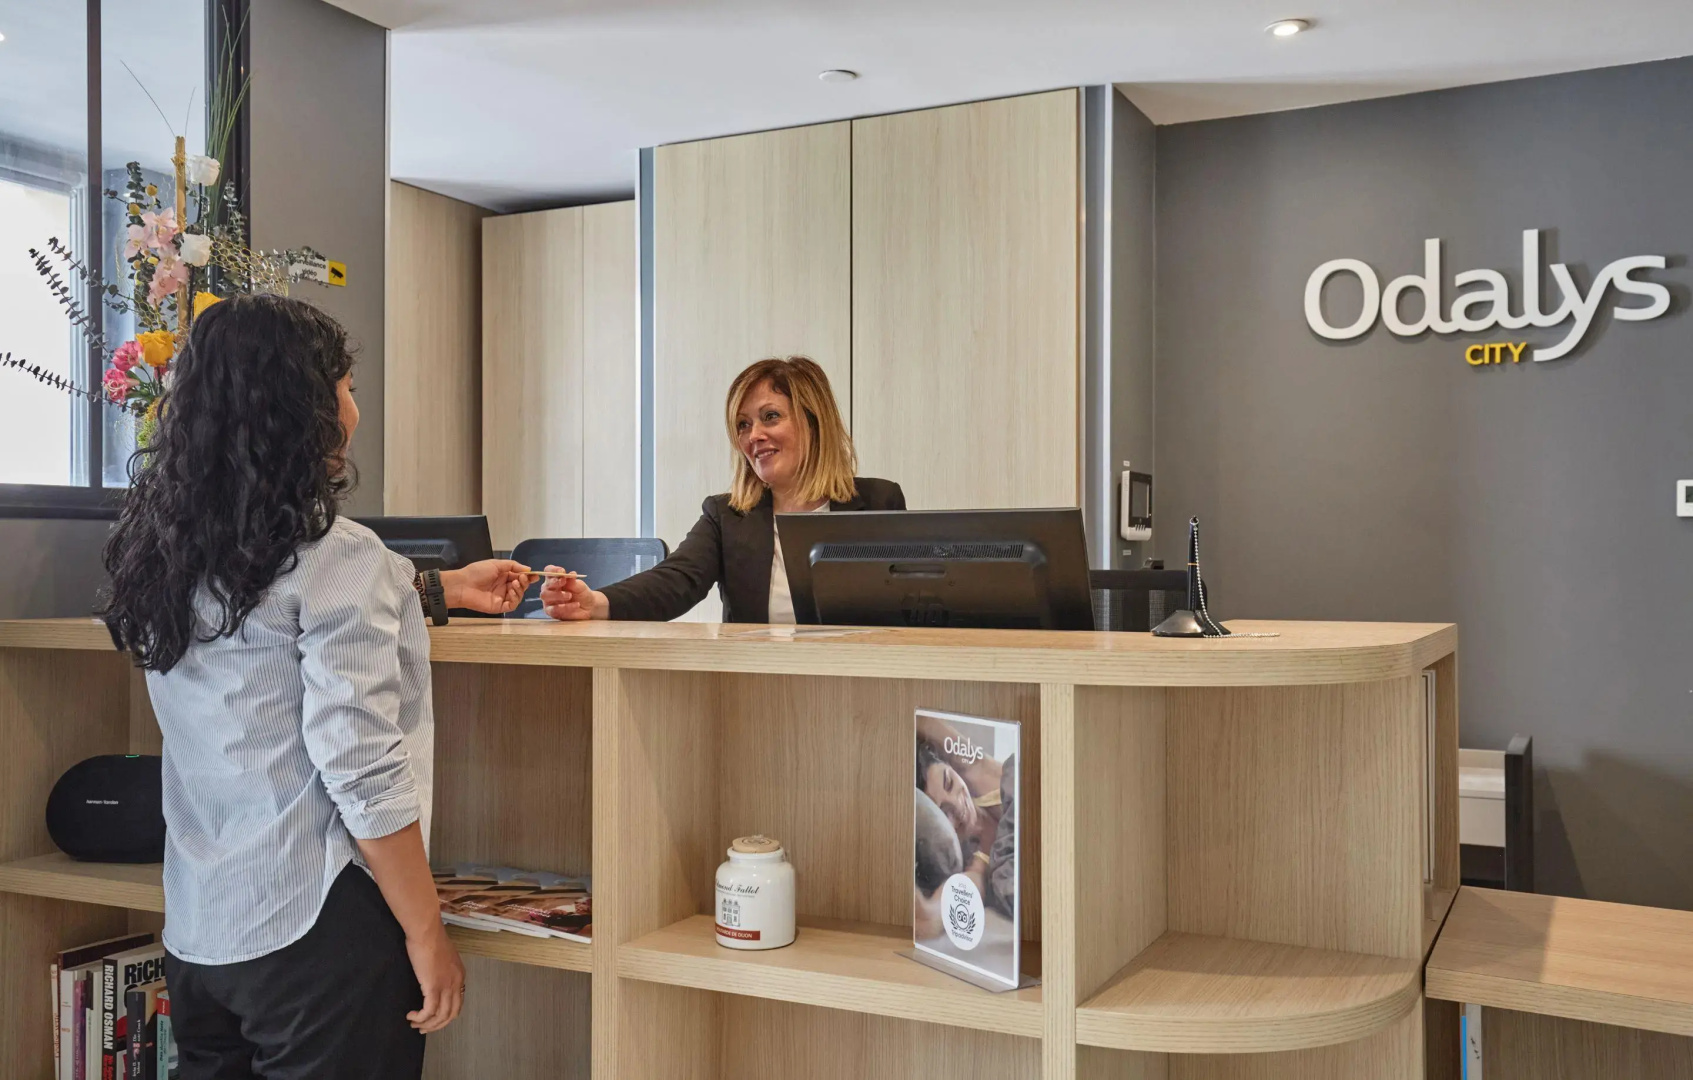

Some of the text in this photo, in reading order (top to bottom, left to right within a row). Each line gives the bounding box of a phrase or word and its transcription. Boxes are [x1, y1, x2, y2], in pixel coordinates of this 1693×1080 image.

[1304, 229, 1670, 362] Odalys
[1465, 342, 1527, 365] CITY
[944, 736, 984, 764] Odalys
[954, 894, 971, 906] Choice
[104, 1012, 114, 1050] OSMAN
